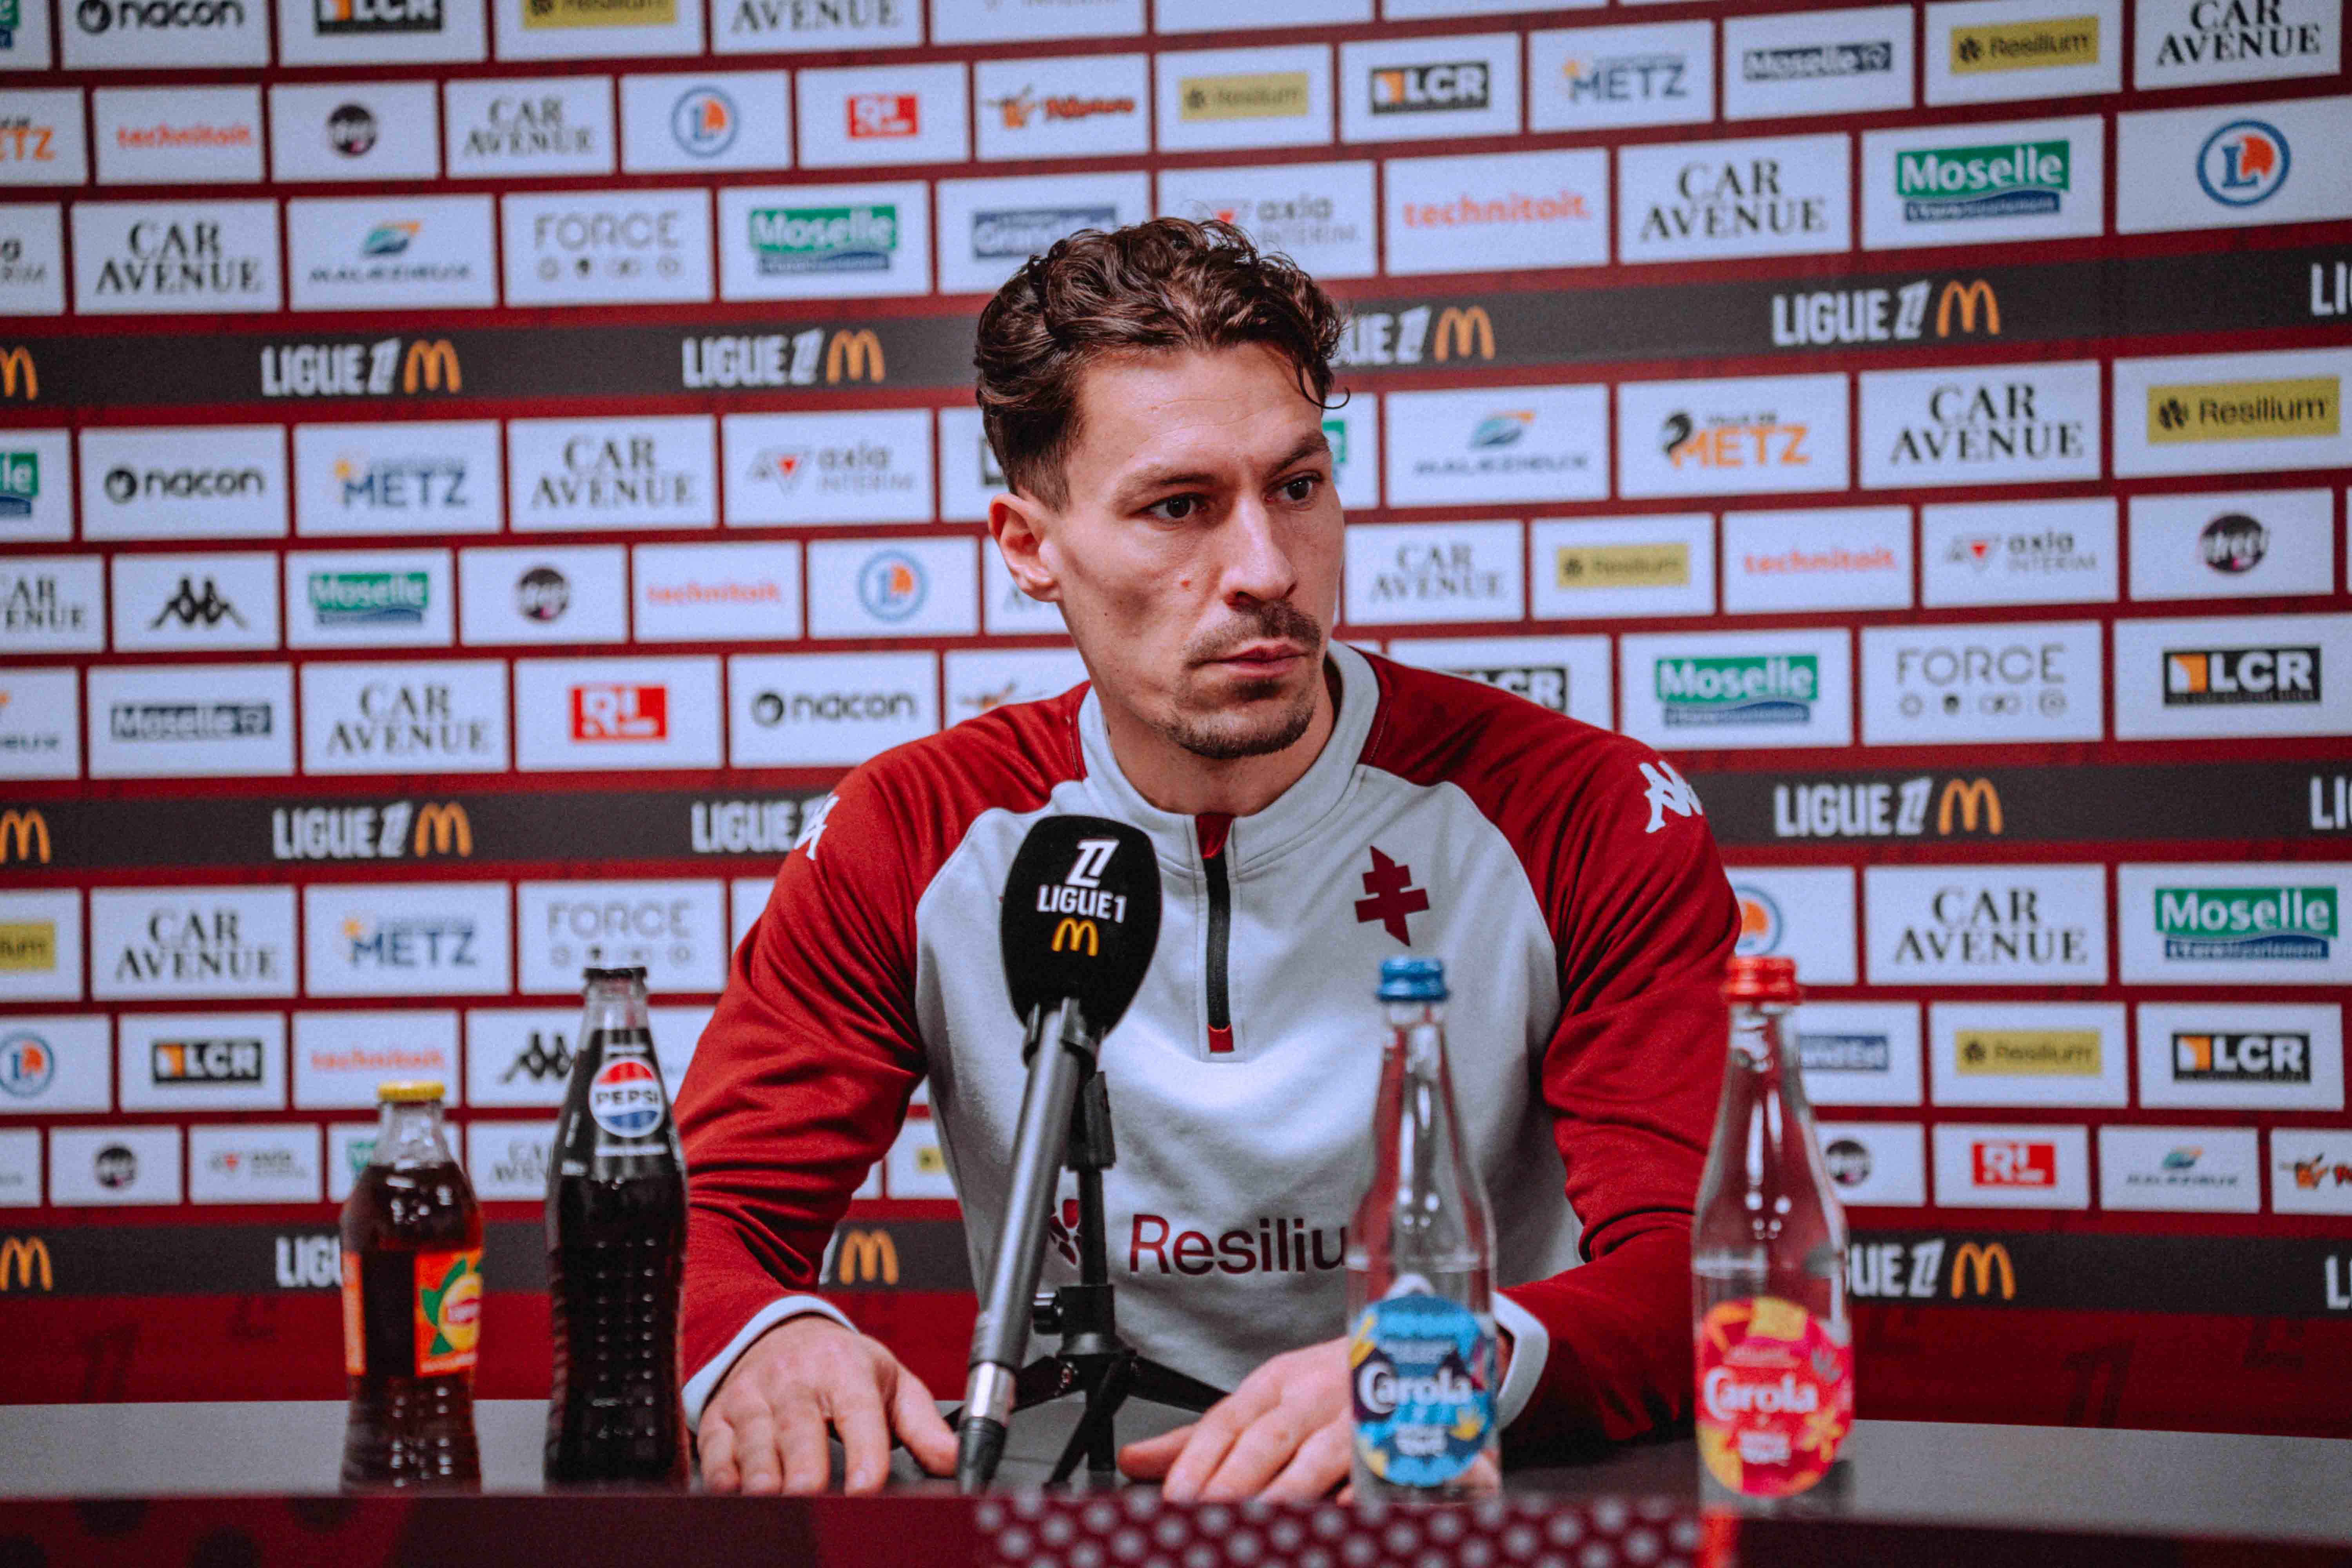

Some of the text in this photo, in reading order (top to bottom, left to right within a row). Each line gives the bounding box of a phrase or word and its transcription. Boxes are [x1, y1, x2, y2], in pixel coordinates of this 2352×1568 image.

[732, 0, 902, 32] AVENUE
[2191, 0, 2282, 30] CAR
[1990, 33, 2087, 58] Resilium
[2159, 24, 2320, 65] AVENUE
[1412, 64, 1486, 103] LCR
[1570, 66, 1688, 105] METZ
[488, 98, 564, 129] CAR
[855, 95, 913, 135] RL
[465, 127, 595, 156] AVENUE
[1678, 161, 1782, 199] CAR
[1900, 144, 2064, 194] Moselle
[534, 211, 678, 250] FORCE
[752, 209, 894, 251] Moselle
[1642, 197, 1828, 239] AVENUE
[128, 222, 222, 259] CAR
[96, 255, 258, 294] AVENUE
[1770, 288, 1891, 347] LIGUE
[259, 343, 365, 397] LIGUE
[681, 334, 788, 388] LIGUE
[1930, 384, 2037, 421] CAR
[2200, 396, 2327, 424] Resilium
[563, 437, 657, 473] CAR
[1670, 425, 1810, 470] METZ
[1893, 419, 2087, 462] AVENUE
[143, 469, 264, 497] nacon
[340, 467, 468, 510] METZ
[532, 472, 692, 508] AVENUE
[1397, 545, 1474, 576] CAR
[0, 575, 59, 608] AR
[311, 575, 426, 608] Moselle
[1373, 572, 1504, 600] AVENUE
[0, 608, 86, 629] ENUE
[1659, 659, 1816, 700] Moselle
[1897, 643, 2065, 686] FORCE
[2208, 649, 2313, 692] LCR
[359, 686, 452, 718] CAR
[581, 686, 660, 739] RL
[791, 692, 916, 721] nacon
[328, 718, 486, 754] AVENUE
[690, 800, 797, 854] LIGUE
[1773, 784, 1891, 839] LIGUE
[272, 806, 377, 859] LIGUE
[548, 900, 690, 939] FORCE
[1036, 884, 1113, 920] LIGUE
[1932, 889, 2040, 925] CAR
[2160, 890, 2332, 933] Moselle
[148, 911, 240, 945] CAR
[1896, 928, 2091, 962] AVENUE
[116, 944, 274, 980] AVENUE
[354, 930, 477, 968] METZ
[185, 1044, 260, 1079] LCR
[2213, 1036, 2306, 1072] LCR
[1985, 1144, 2045, 1185] RL
[1129, 1212, 1348, 1274] Resiliu
[1359, 1361, 1474, 1414] Carola
[1704, 1366, 1818, 1421] Carola
